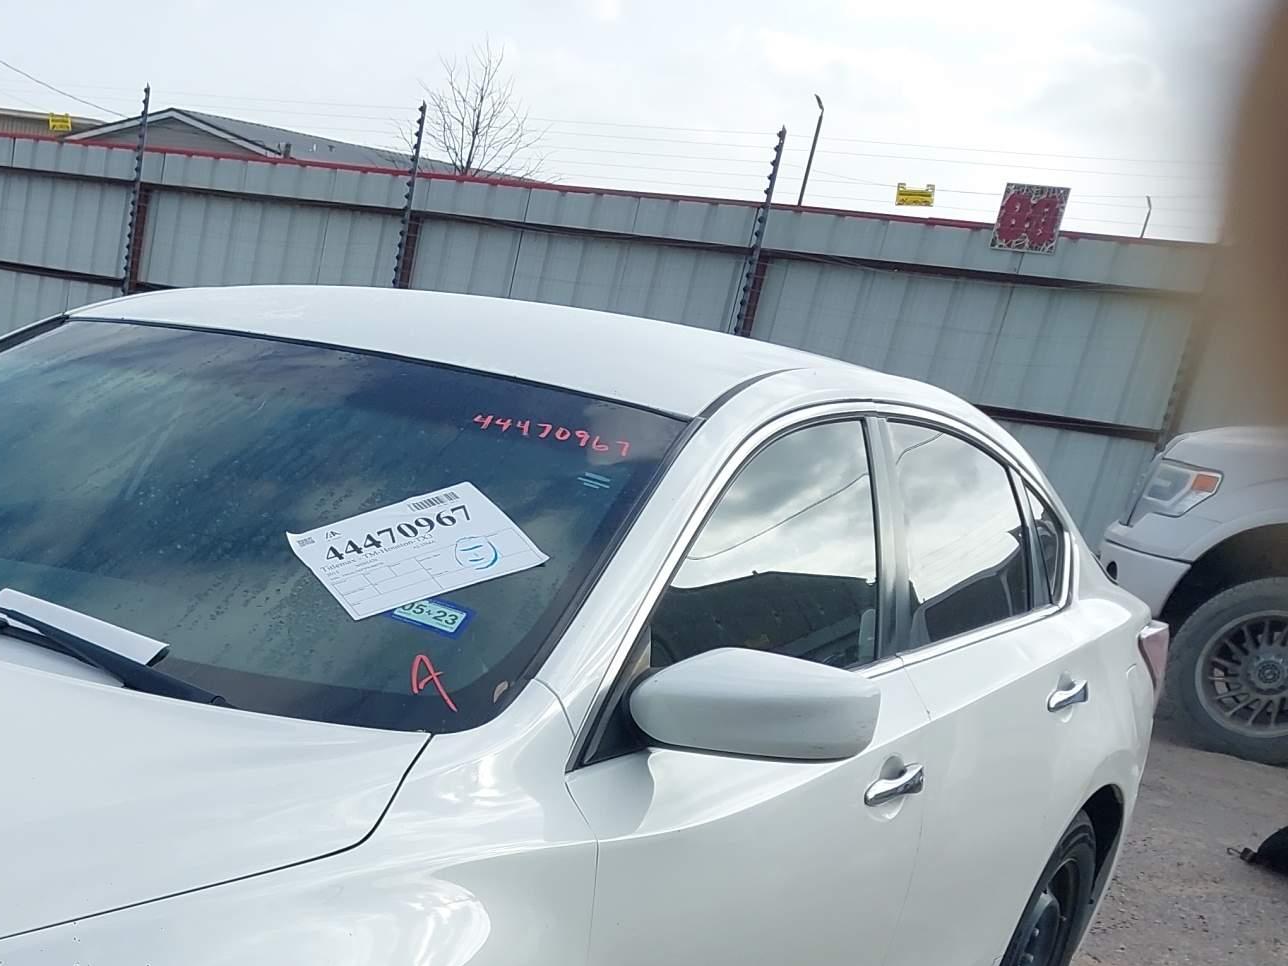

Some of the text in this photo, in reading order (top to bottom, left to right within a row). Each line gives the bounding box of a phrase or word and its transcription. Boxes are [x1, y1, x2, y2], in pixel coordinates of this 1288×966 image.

[473, 415, 630, 456] 44470967
[326, 505, 471, 560] 44470967
[433, 610, 458, 625] 23
[412, 654, 458, 712] A
